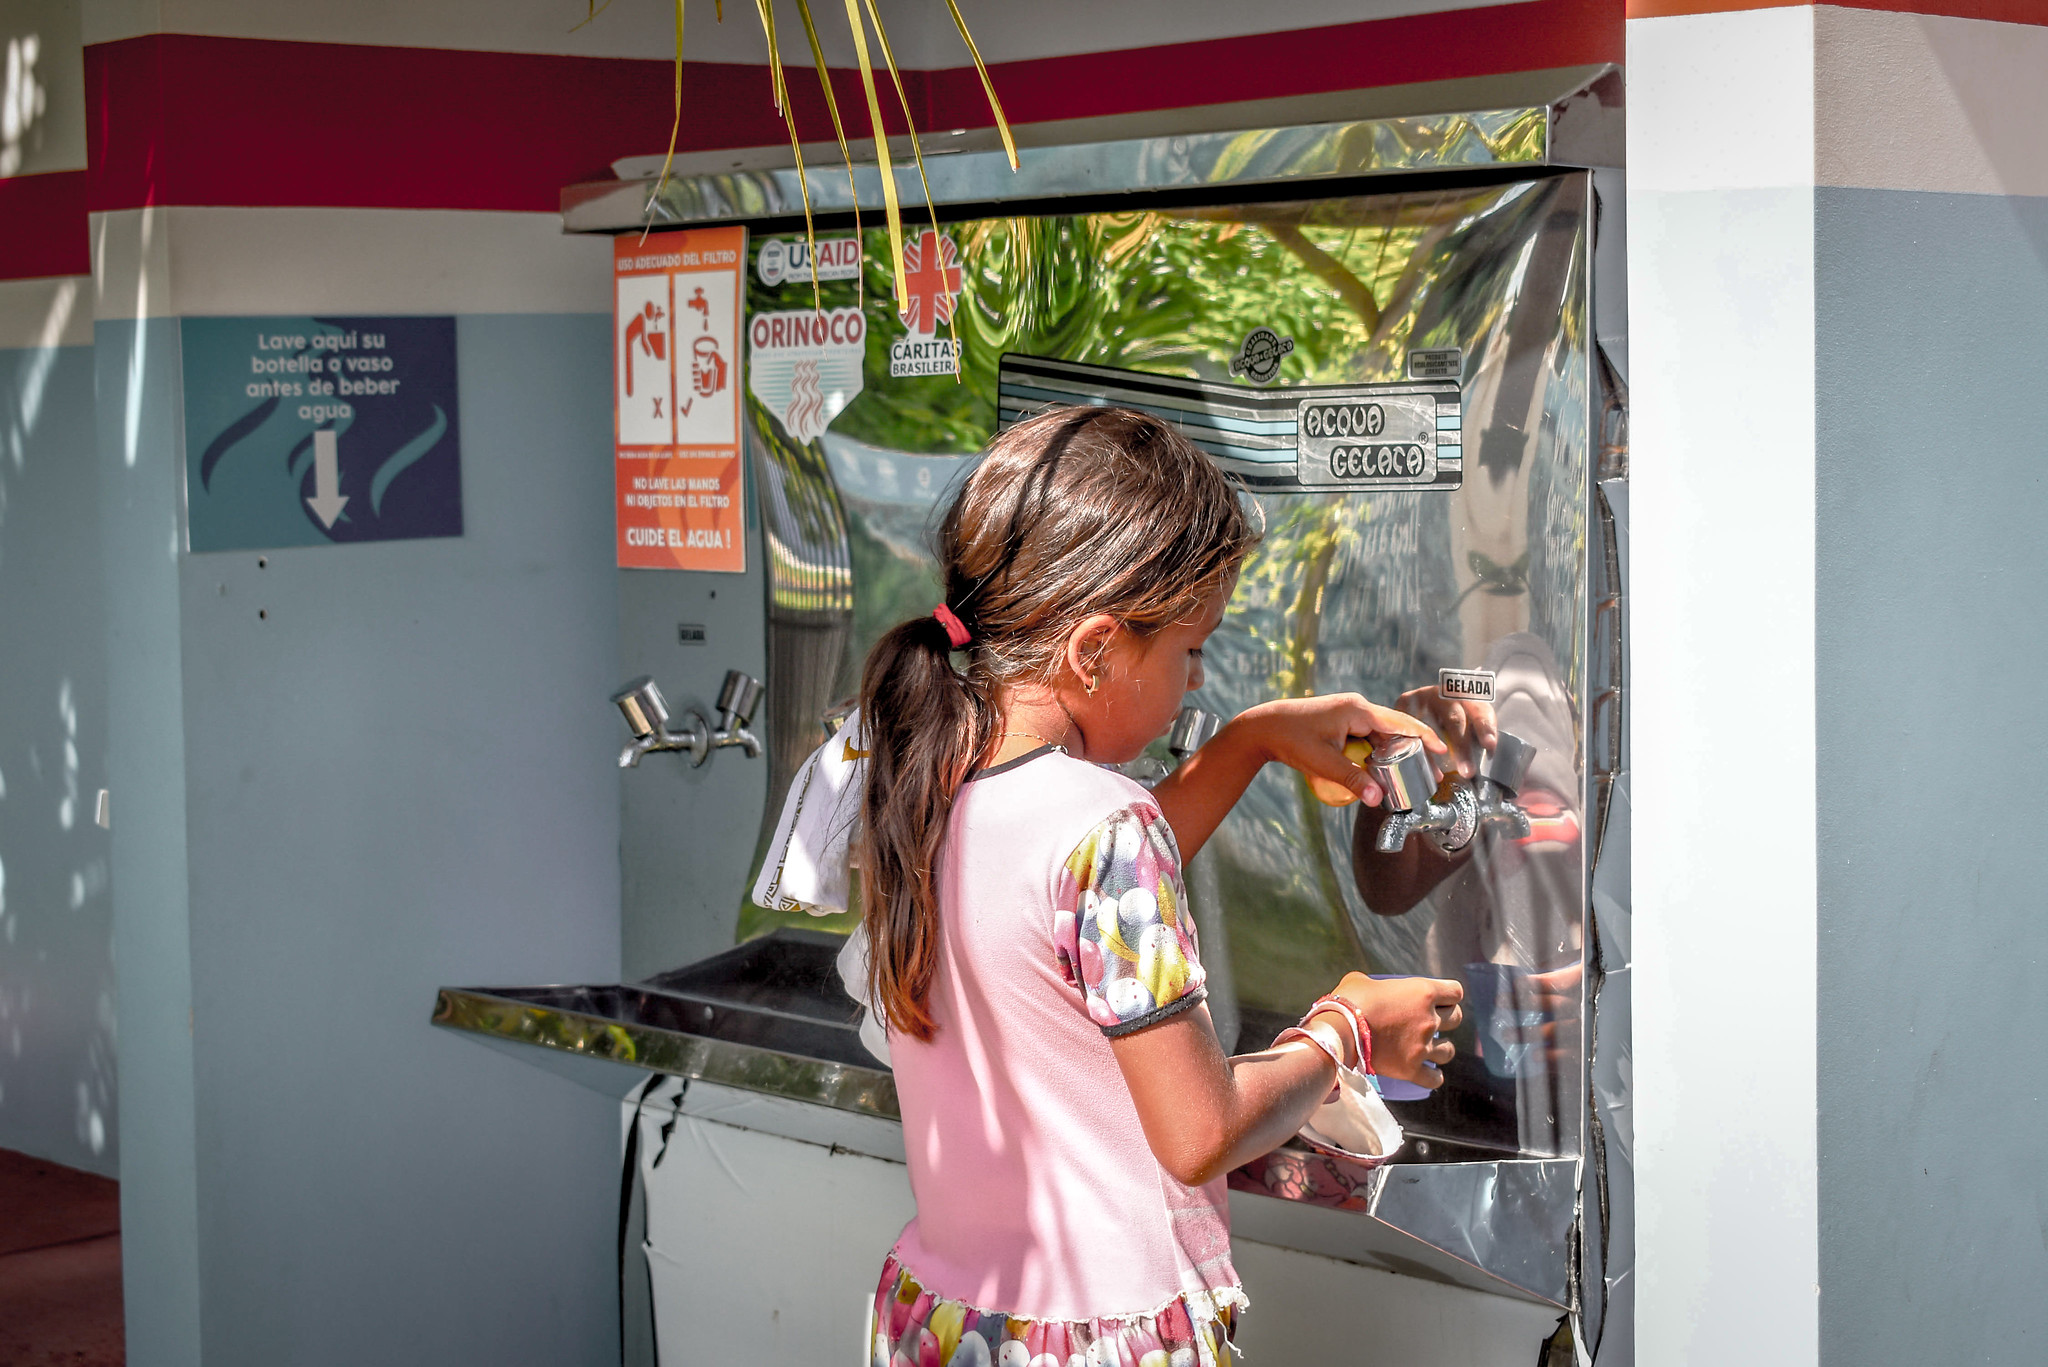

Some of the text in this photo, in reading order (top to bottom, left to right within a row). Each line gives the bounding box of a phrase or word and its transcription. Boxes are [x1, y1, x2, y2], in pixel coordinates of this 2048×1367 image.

[618, 250, 737, 271] USO ADECUADO DEL FILTRO
[754, 313, 863, 349] ORINOCO
[258, 331, 385, 352] Lave aquí su
[893, 339, 960, 360] CÁRITAS
[252, 356, 393, 373] botella o vaso
[246, 377, 400, 398] antes de beber
[298, 404, 351, 424] agua
[1307, 406, 1382, 437] ACQUA
[634, 477, 720, 491] NO LAVE LAS MANOS
[626, 494, 730, 509] NI OBJETOS EN EL FILTRO
[627, 528, 666, 546] CUIDE
[668, 529, 684, 547] EL
[687, 530, 723, 548] AGUA
[1446, 679, 1491, 695] GELADA
